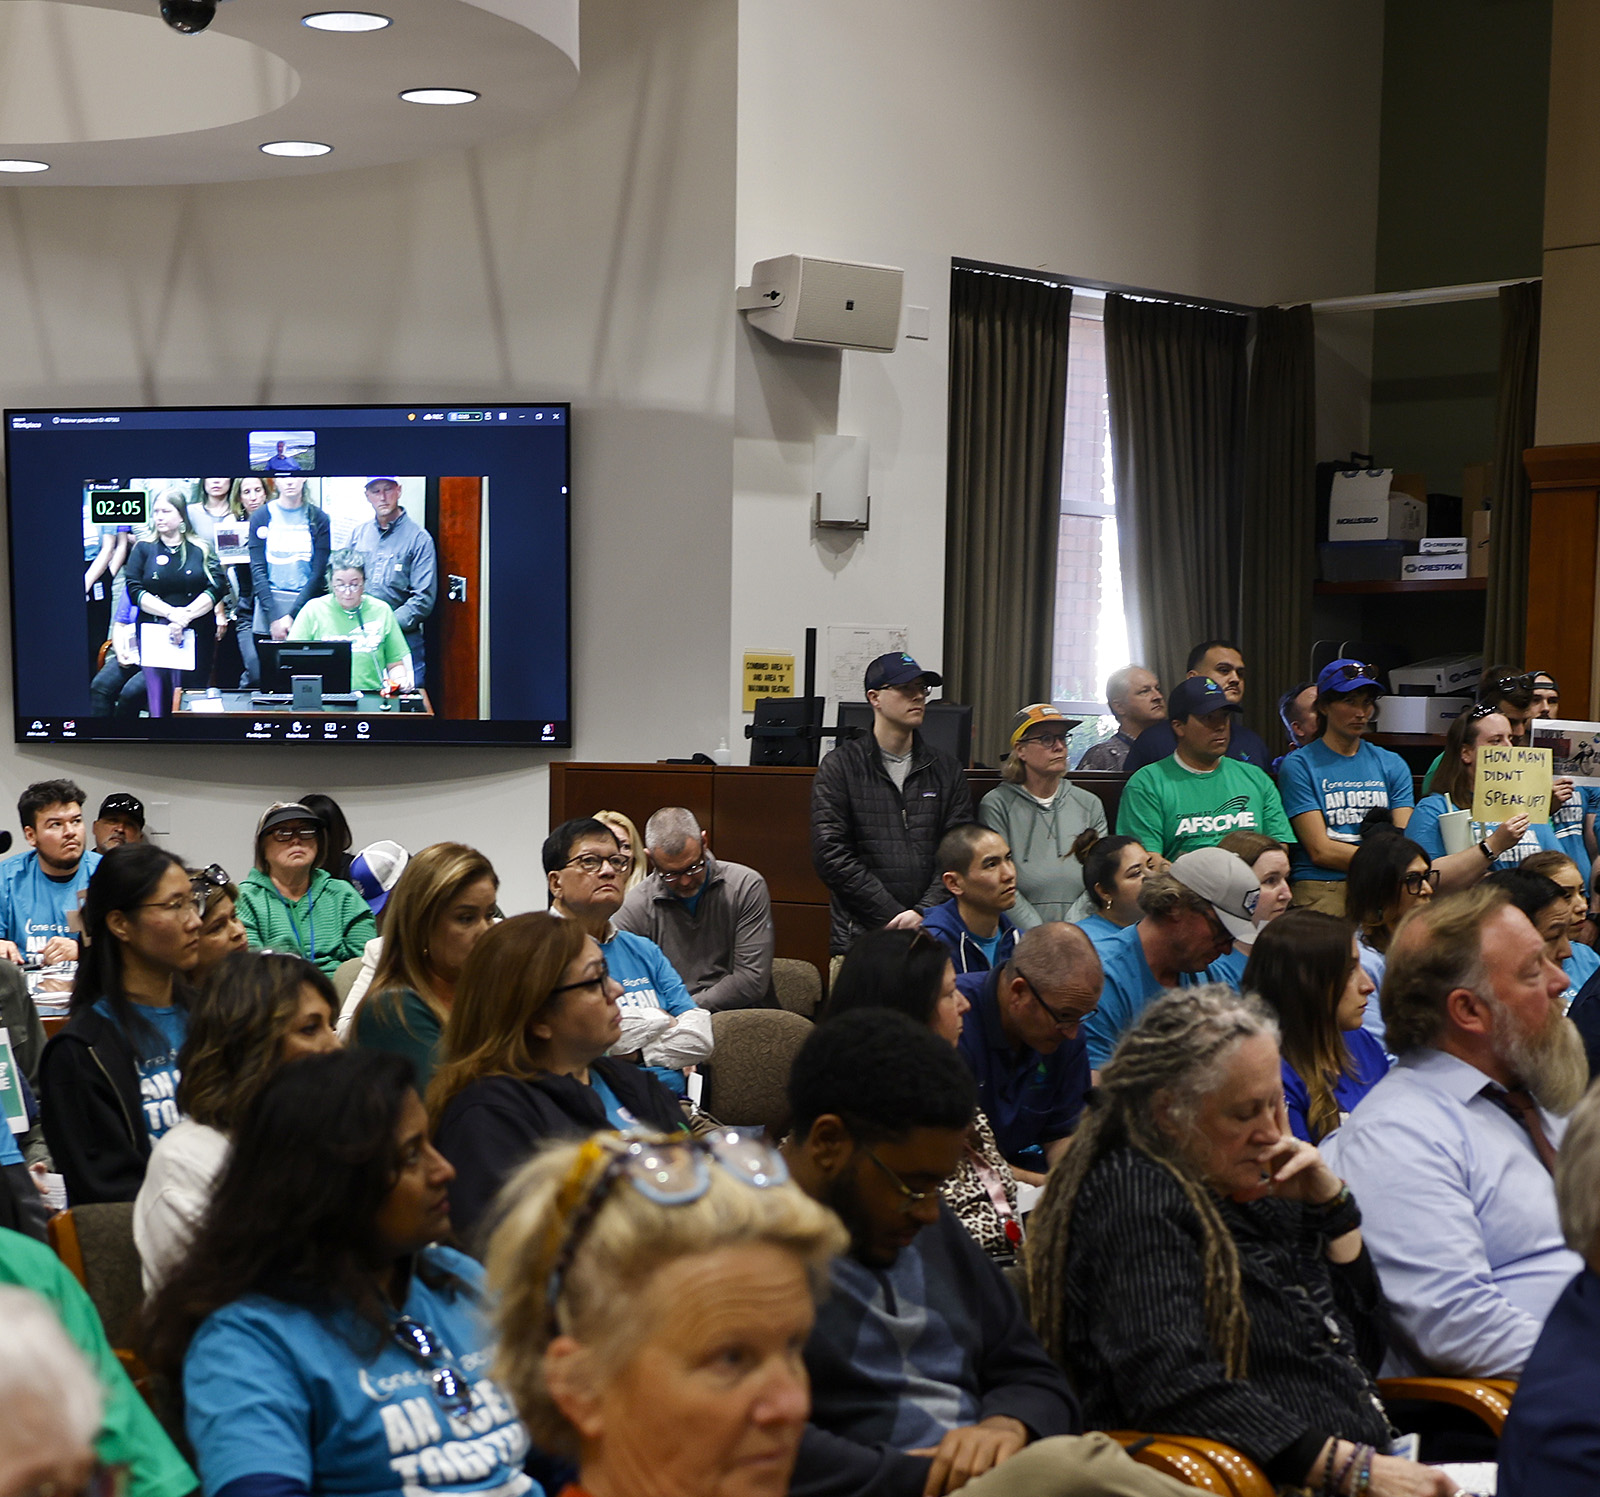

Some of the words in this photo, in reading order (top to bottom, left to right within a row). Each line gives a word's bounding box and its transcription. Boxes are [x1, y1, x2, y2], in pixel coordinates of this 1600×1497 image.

[96, 500, 141, 516] 02:05
[1417, 563, 1464, 572] CRESTRON
[1483, 751, 1512, 765] HOW
[1517, 751, 1546, 768] MANY
[1483, 770, 1524, 782] DIDN'T
[1325, 791, 1346, 810] AN
[1346, 790, 1389, 809] OCEAN
[1483, 789, 1525, 807] SPEAK
[1527, 794, 1546, 812] UP?
[1175, 811, 1255, 837] AFSCME
[26, 936, 47, 953] AN
[379, 1397, 443, 1455] AN
